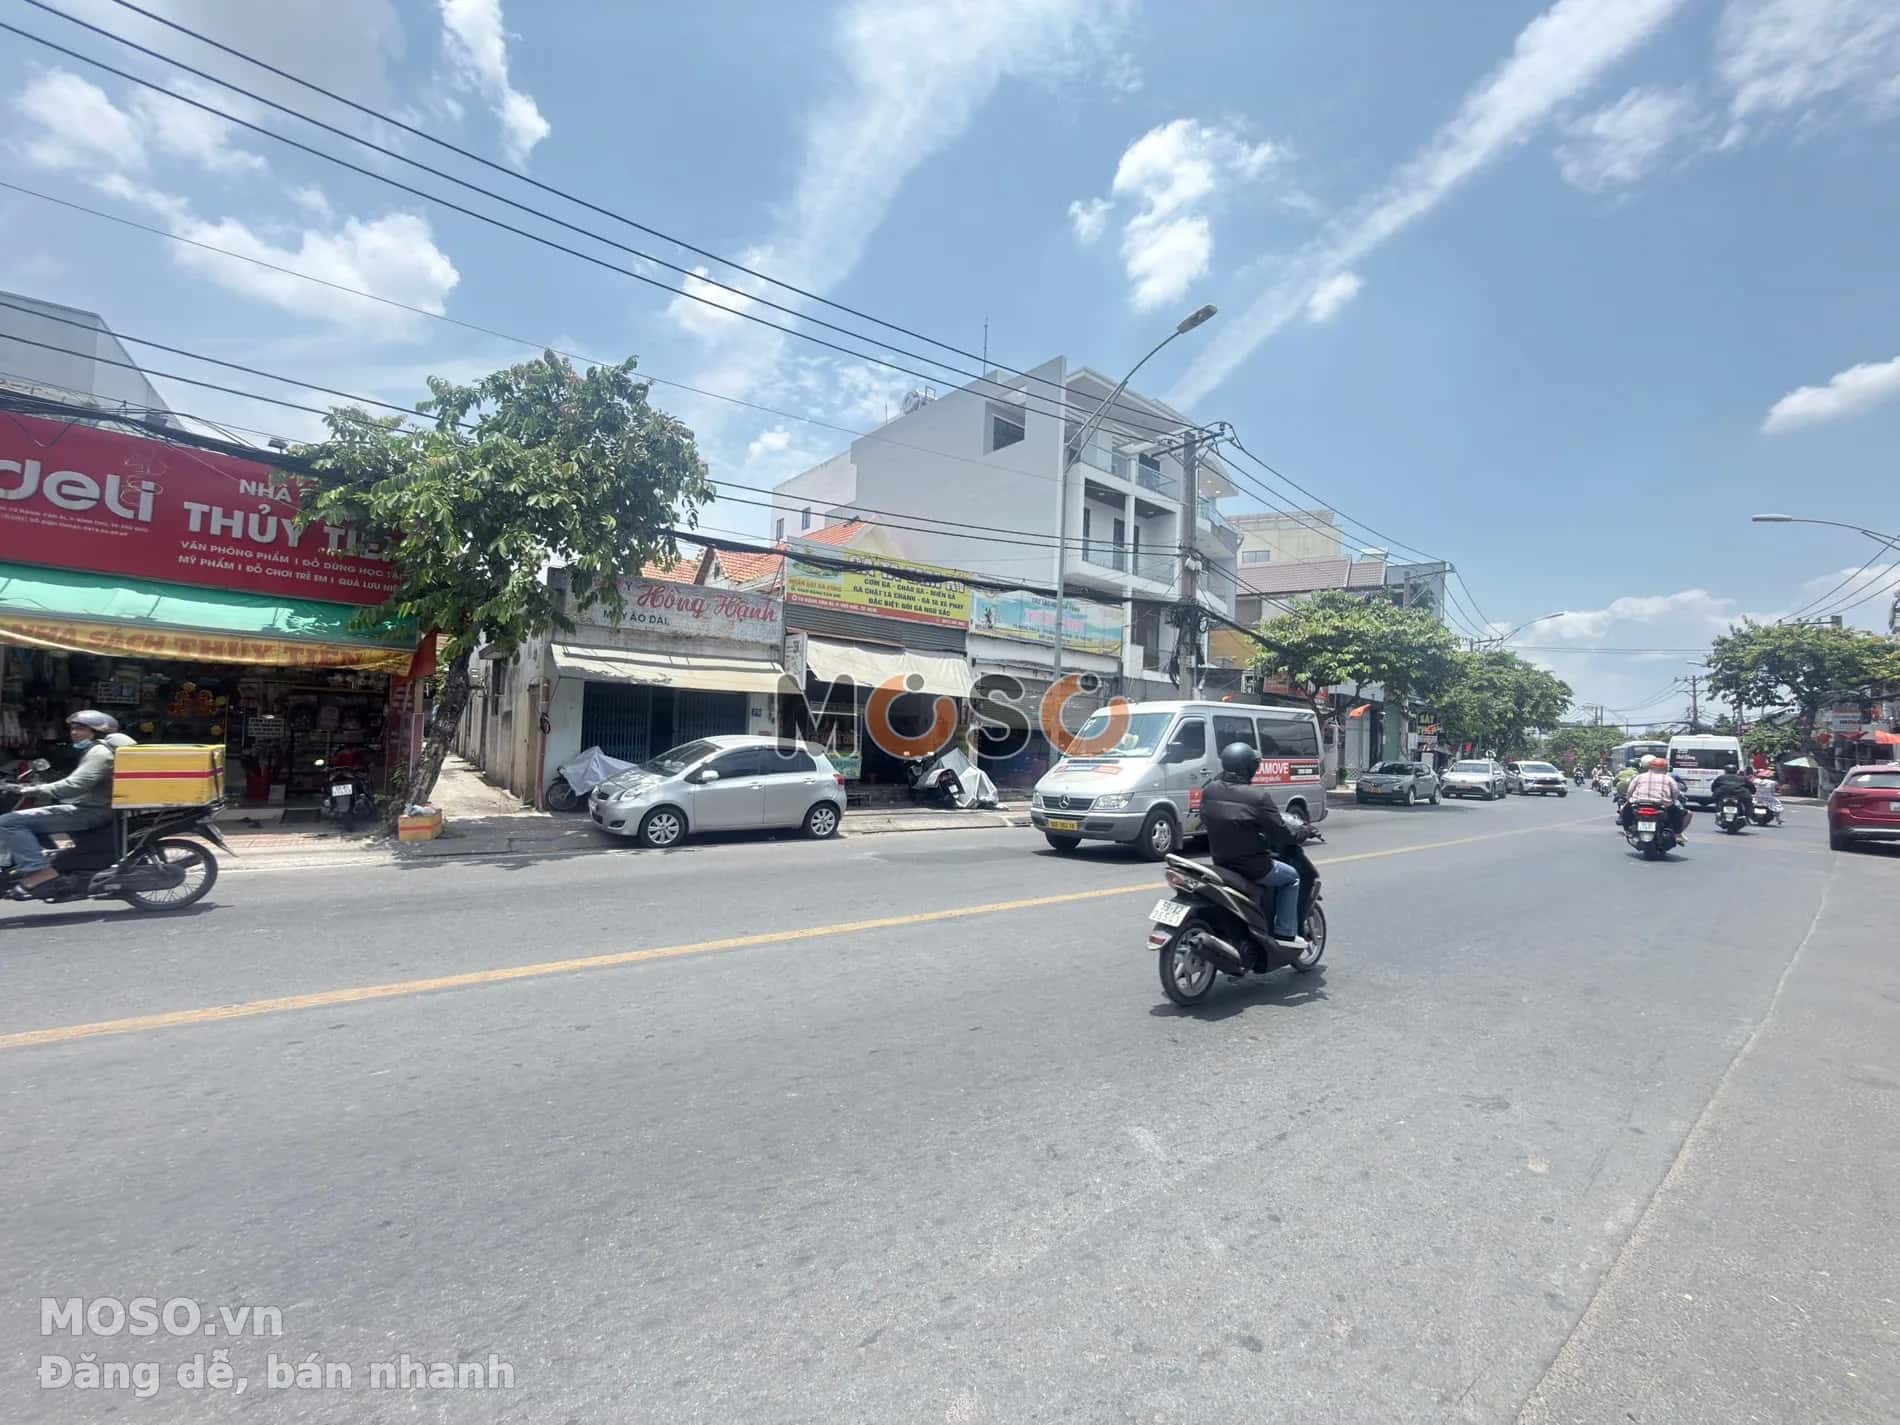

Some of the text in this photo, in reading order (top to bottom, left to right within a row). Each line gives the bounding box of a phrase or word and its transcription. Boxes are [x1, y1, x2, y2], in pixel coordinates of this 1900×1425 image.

[239, 478, 292, 503] NHÀ
[184, 502, 304, 548] THỦY
[210, 545, 253, 558] PHÒNG
[360, 567, 384, 577] HỌC
[314, 574, 328, 583] EM
[637, 583, 706, 618] Hồng
[714, 593, 777, 622] Hạnh
